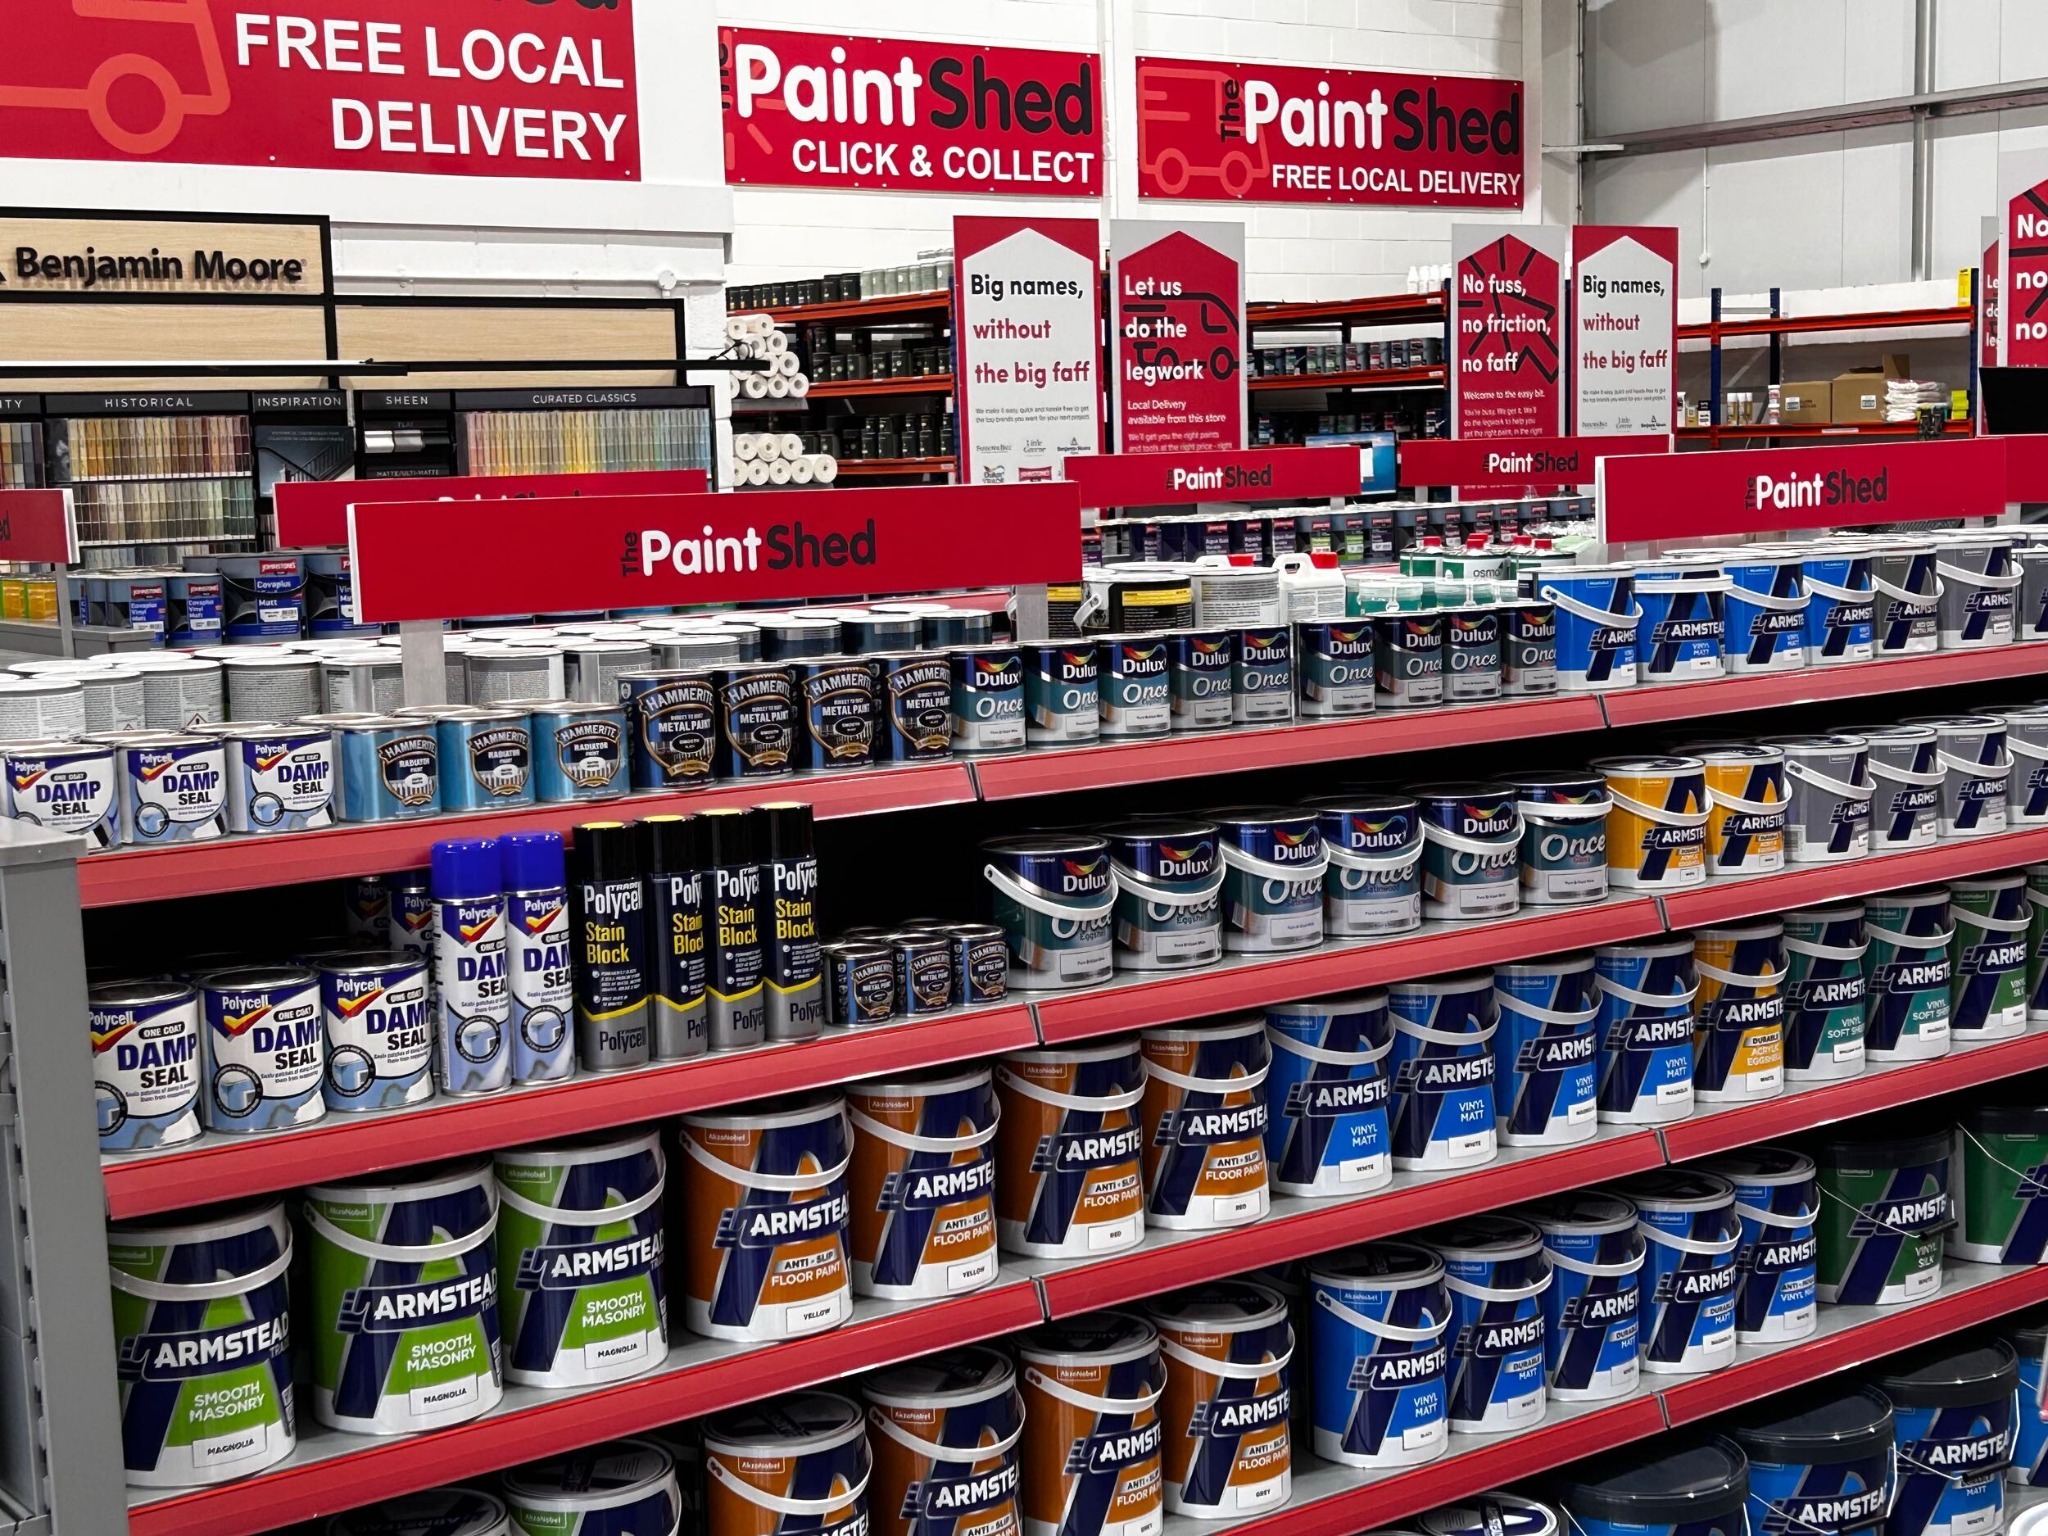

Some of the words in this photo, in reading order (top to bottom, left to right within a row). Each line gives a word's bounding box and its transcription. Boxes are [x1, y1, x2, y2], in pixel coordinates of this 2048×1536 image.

[235, 12, 406, 77] FREE
[425, 25, 624, 90] LOCAL
[1219, 79, 1239, 142] The
[331, 97, 627, 162] DELIVERY
[792, 138, 899, 177] CLICK
[909, 144, 934, 179] &
[943, 146, 1094, 184] COLLECT
[1273, 165, 1332, 190] FREE
[1339, 167, 1411, 193] LOCAL
[1419, 169, 1521, 196] DELIVERY
[15, 246, 183, 288] Benjamin
[194, 249, 302, 283] Moore
[970, 274, 1003, 301] Big
[1010, 278, 1084, 299] names,
[1124, 275, 1154, 296] Let
[1161, 280, 1182, 295] us
[1463, 274, 1484, 293] No
[1489, 274, 1527, 297] fuss,
[1583, 275, 1607, 298] Big
[1611, 278, 1665, 297] names,
[2016, 270, 2047, 289] no
[973, 318, 1051, 340] without
[1125, 319, 1148, 338] do
[1156, 317, 1187, 338] the
[1462, 318, 1483, 333] no
[1487, 313, 1551, 335] friction,
[1583, 313, 1640, 331] without
[2016, 322, 2047, 341] no
[1462, 357, 1483, 372] no
[1487, 352, 1518, 372] faff
[1583, 351, 1607, 369] the
[1612, 350, 1635, 373] big
[1639, 350, 1668, 368] faff
[975, 362, 1008, 384] the
[1014, 361, 1046, 389] big
[1052, 360, 1090, 382] faff
[1126, 359, 1204, 386] legwork
[105, 397, 194, 408] HISTORICAL
[257, 396, 342, 407] INSPIRATION
[386, 396, 428, 405] SHEEN
[532, 394, 583, 404] CURATED
[586, 393, 637, 403] CLASSICS
[1464, 390, 1495, 400] Welcome
[1496, 390, 1503, 399] to
[1505, 390, 1517, 399] the
[1519, 389, 1533, 401] easy
[1128, 400, 1150, 410] Local
[1152, 400, 1186, 410] Delivery
[1128, 415, 1165, 424] available
[1167, 414, 1186, 423] from
[1189, 414, 1204, 423] this
[1206, 414, 1226, 423] store
[1745, 476, 1757, 510] The
[621, 531, 639, 577] The
[1473, 568, 1500, 578] osmo
[1451, 628, 1495, 642] Dulux
[1122, 660, 1165, 674] Dulux
[1450, 652, 1497, 670] Once
[975, 672, 1020, 687] Dulux
[646, 688, 713, 712] HAMMERITE
[1122, 684, 1168, 703] Once
[976, 698, 1023, 718] Once
[561, 723, 618, 741] HAMMERITE
[658, 721, 690, 733] METAL
[690, 718, 711, 731] PAINT
[574, 742, 608, 751] RADIATOR
[15, 761, 47, 773] Polycell
[139, 752, 174, 764] Polycell
[163, 770, 220, 793] DAMP
[36, 780, 101, 803] DAMP
[178, 791, 212, 806] SEAL
[52, 801, 90, 816] SEAL
[1463, 817, 1509, 835] Dulux
[1350, 830, 1402, 849] Dulux
[1540, 832, 1606, 862] Once
[1159, 856, 1211, 877] Dulux
[459, 907, 497, 923] Polycell
[718, 903, 754, 925] Stain
[586, 921, 625, 942] Stain
[719, 925, 758, 947] Block
[586, 944, 629, 964] Block
[222, 995, 269, 1010] Polycell
[1927, 999, 1946, 1009] VINYL
[278, 1011, 293, 1021] ONE
[294, 1007, 313, 1019] COAT
[1912, 1011, 1934, 1021] SOFT
[143, 1027, 162, 1038] ONE
[163, 1023, 182, 1035] COAT
[253, 1017, 322, 1053] DAMP
[1751, 1032, 1779, 1045] DURABLE
[117, 1033, 196, 1071] DAMP
[275, 1049, 317, 1070] SEAL
[1665, 1057, 1687, 1070] VINYL
[1666, 1067, 1687, 1078] MATT
[140, 1068, 189, 1089] SEAL
[1459, 1100, 1485, 1113] VINYL
[1461, 1110, 1485, 1122] MATT
[1350, 1123, 1378, 1138] VINYL
[1352, 1134, 1377, 1148] MATT
[1356, 1163, 1374, 1172] WHITE
[1084, 1194, 1120, 1208] FLOOR
[1121, 1187, 1140, 1202] PAINT
[1110, 1230, 1122, 1238] RED
[1915, 1245, 1938, 1257] VINYL
[784, 1258, 808, 1270] ANTI
[816, 1252, 834, 1265] SLIP
[1918, 1255, 1934, 1267] SILK
[771, 1271, 814, 1287] FLOOR
[816, 1262, 841, 1280] PAINT
[803, 1307, 831, 1321] YELLOW
[154, 1312, 289, 1368] ARMSTEAD
[411, 1333, 473, 1359] SMOOTH
[407, 1346, 477, 1372] MASONRY
[1519, 1368, 1537, 1380] MATT
[194, 1380, 260, 1407] SMOOTH
[424, 1387, 467, 1404] MAGNOLIA
[1413, 1393, 1438, 1407] VINYL
[190, 1393, 265, 1423] MASONRY
[1415, 1405, 1437, 1417] MATT
[207, 1438, 255, 1456] MAGNOLIA
[1256, 1489, 1271, 1498] GREY
[1966, 1486, 1987, 1496] MATT
